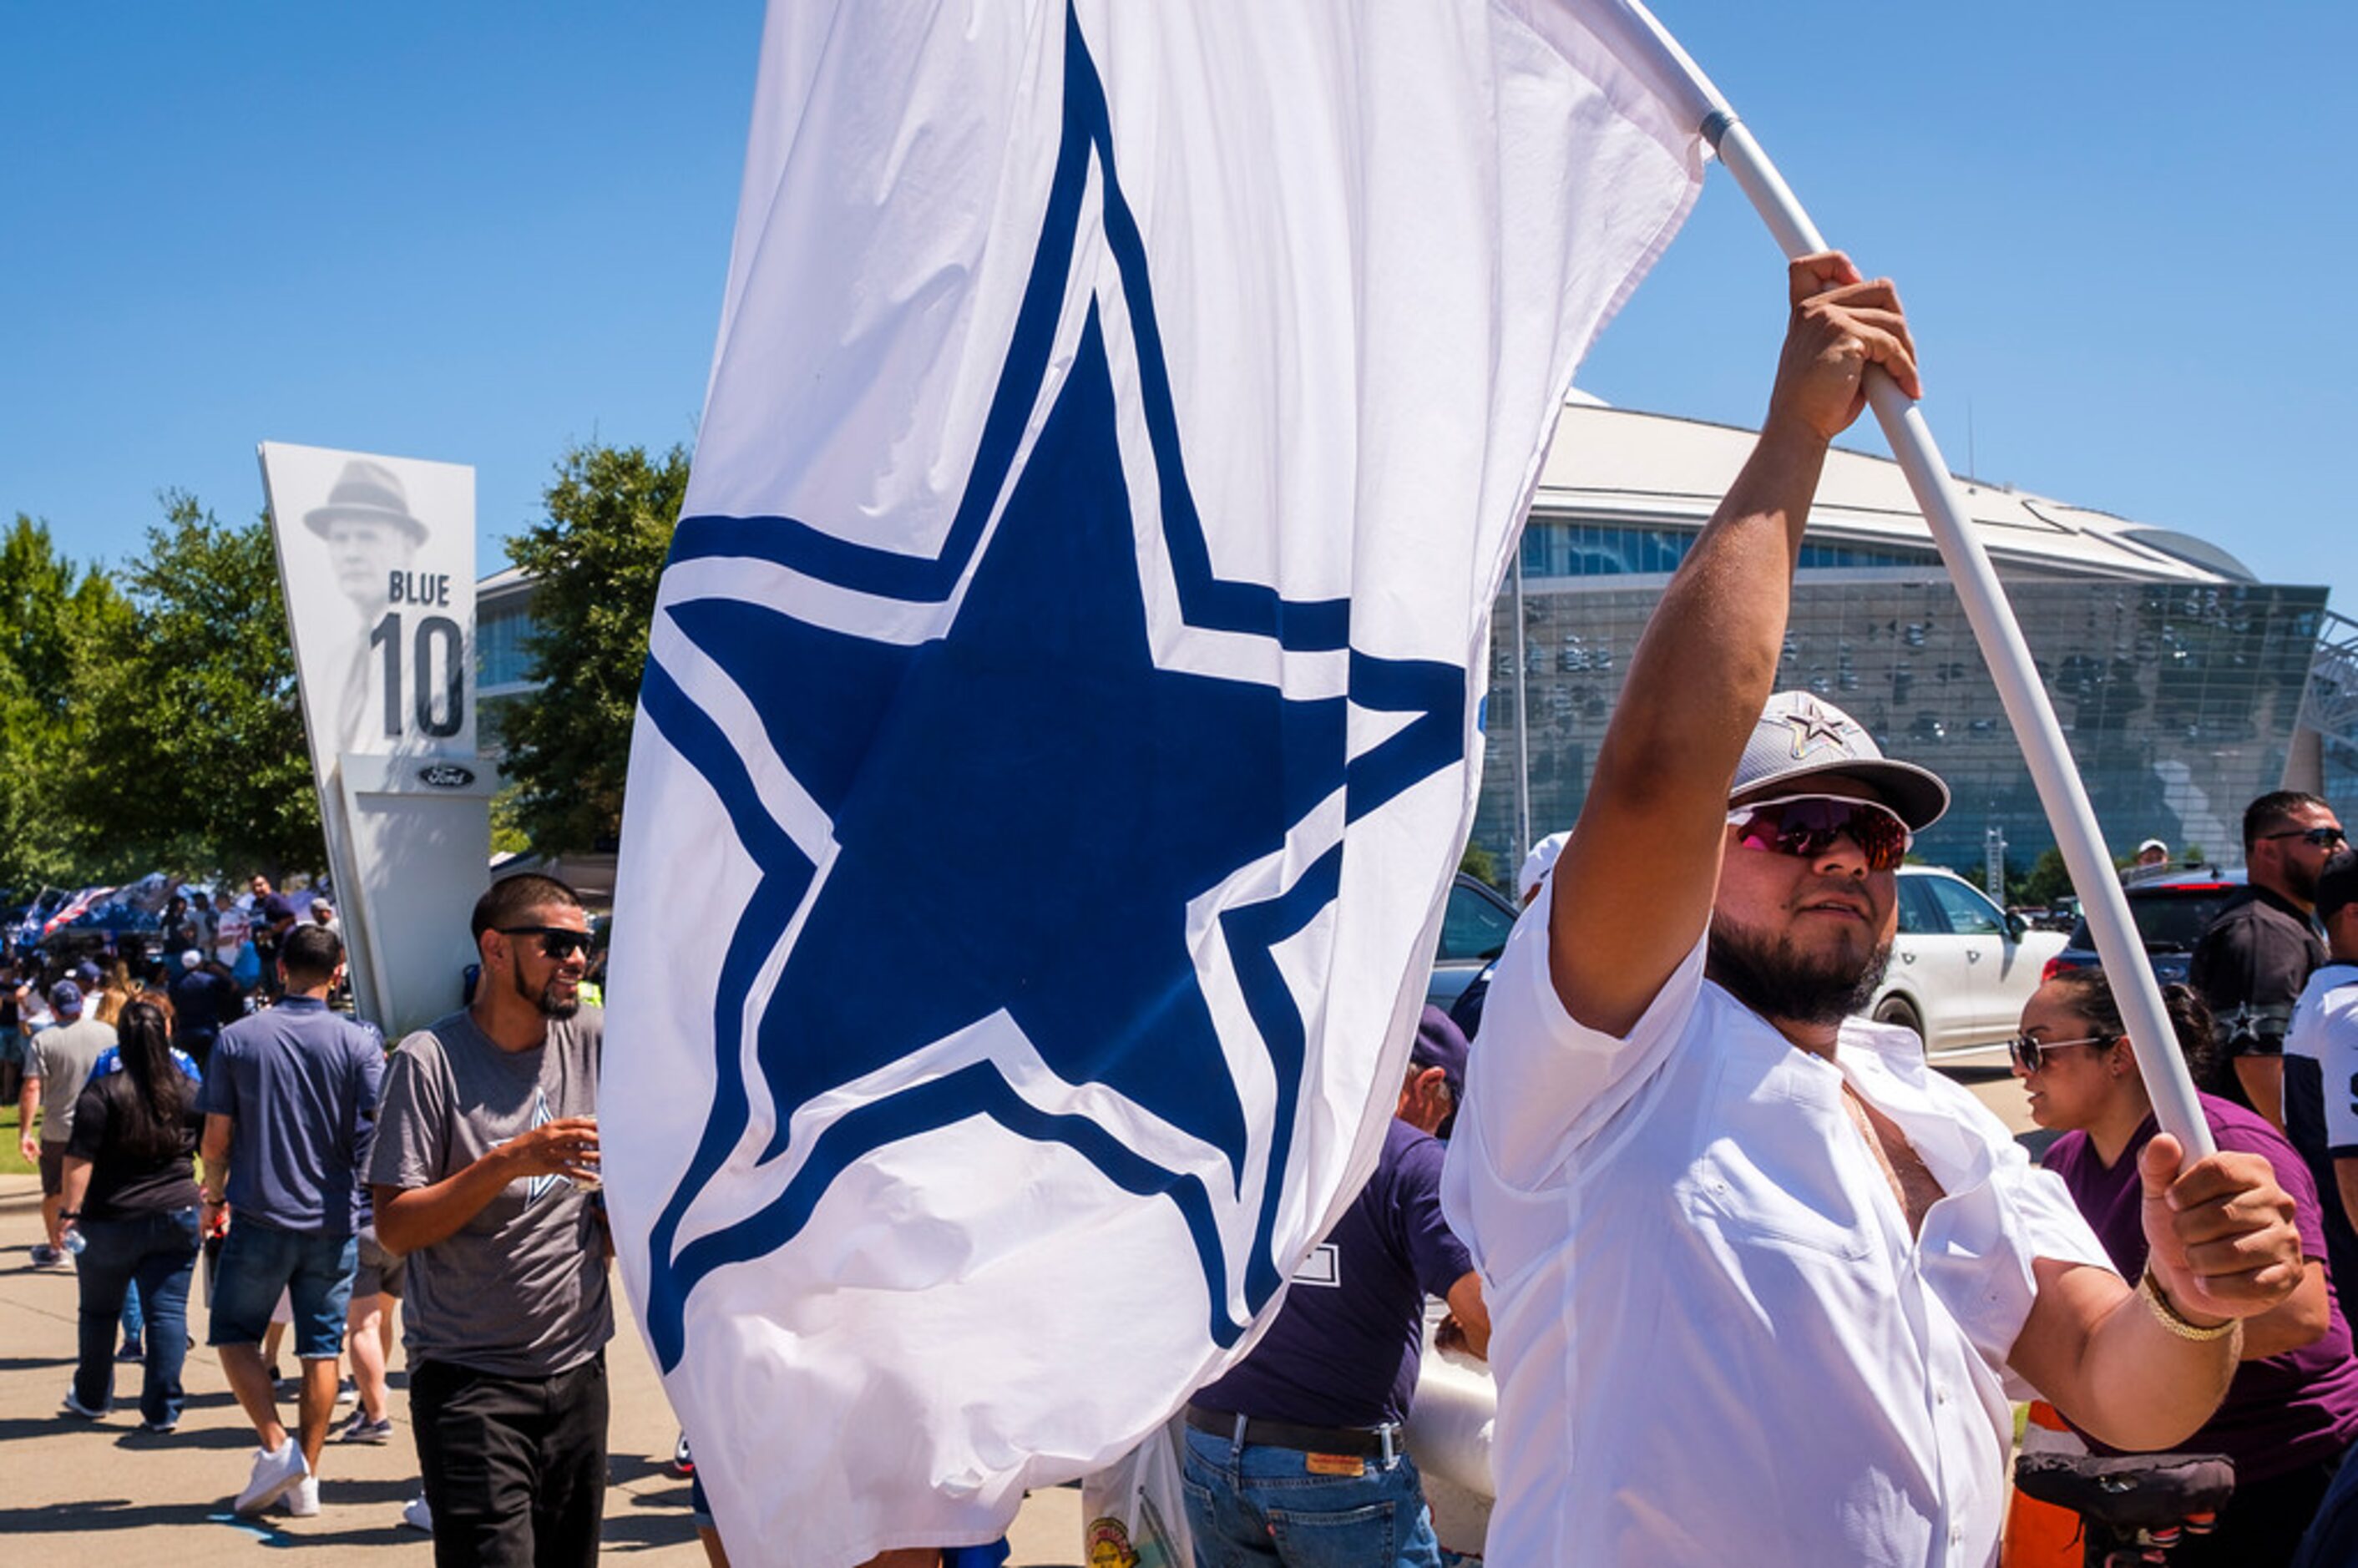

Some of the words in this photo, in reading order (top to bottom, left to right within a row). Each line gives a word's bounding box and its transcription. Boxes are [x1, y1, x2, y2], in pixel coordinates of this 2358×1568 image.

[389, 570, 450, 606] BLUE
[370, 612, 463, 736] 10
[426, 766, 466, 786] Ford
